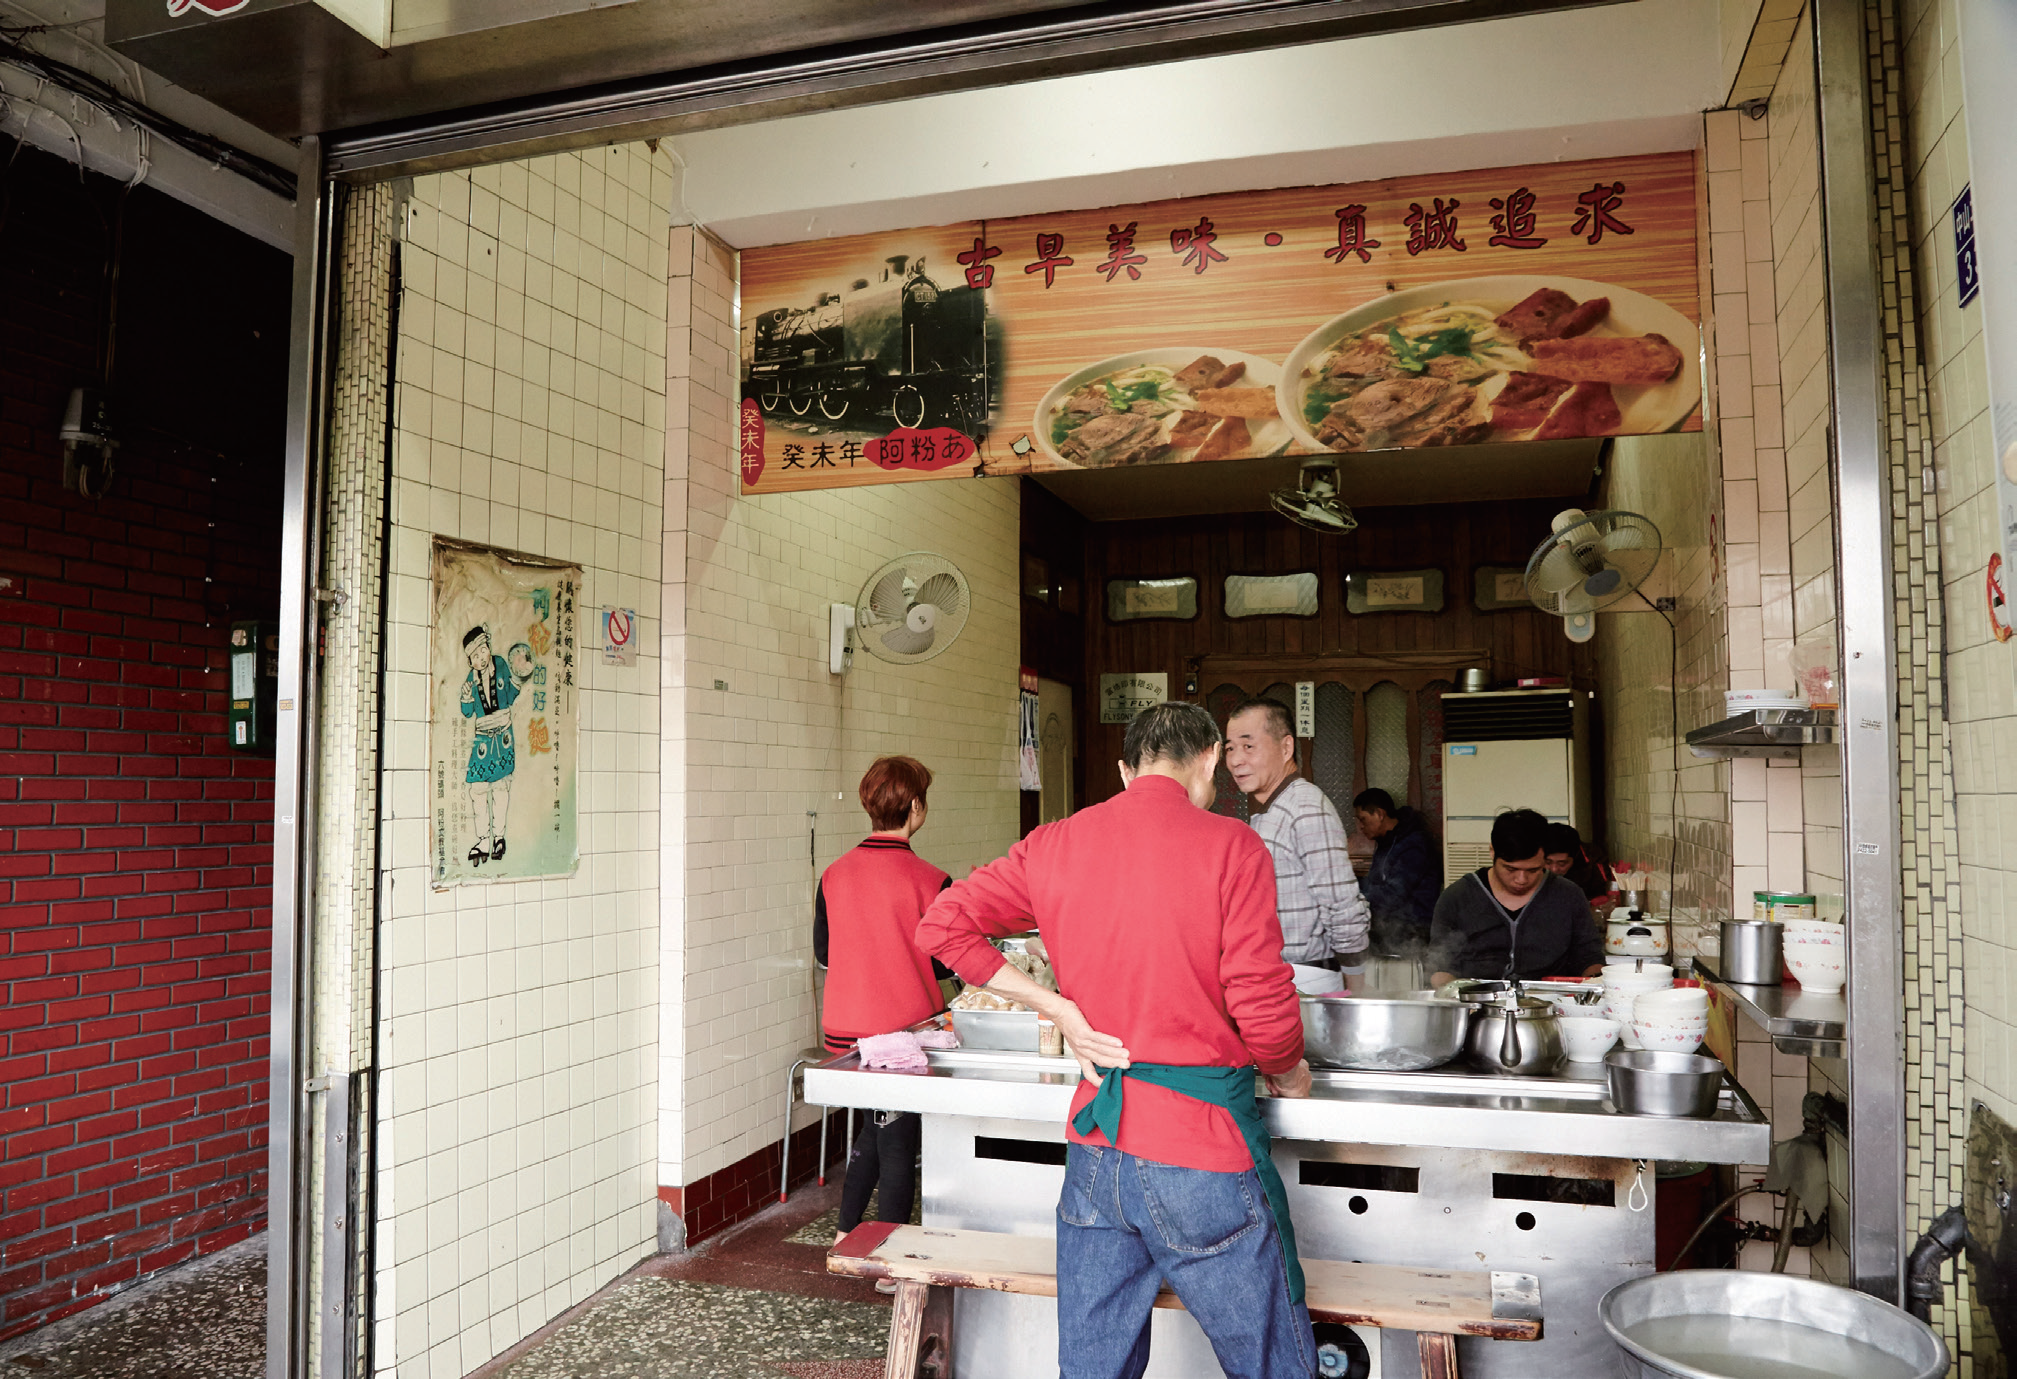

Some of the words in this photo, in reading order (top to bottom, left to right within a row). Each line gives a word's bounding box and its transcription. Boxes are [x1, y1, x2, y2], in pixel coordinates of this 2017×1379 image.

[1956, 203, 1973, 241] 中山
[741, 408, 760, 475] 癸未年
[781, 440, 865, 470] 癸未年
